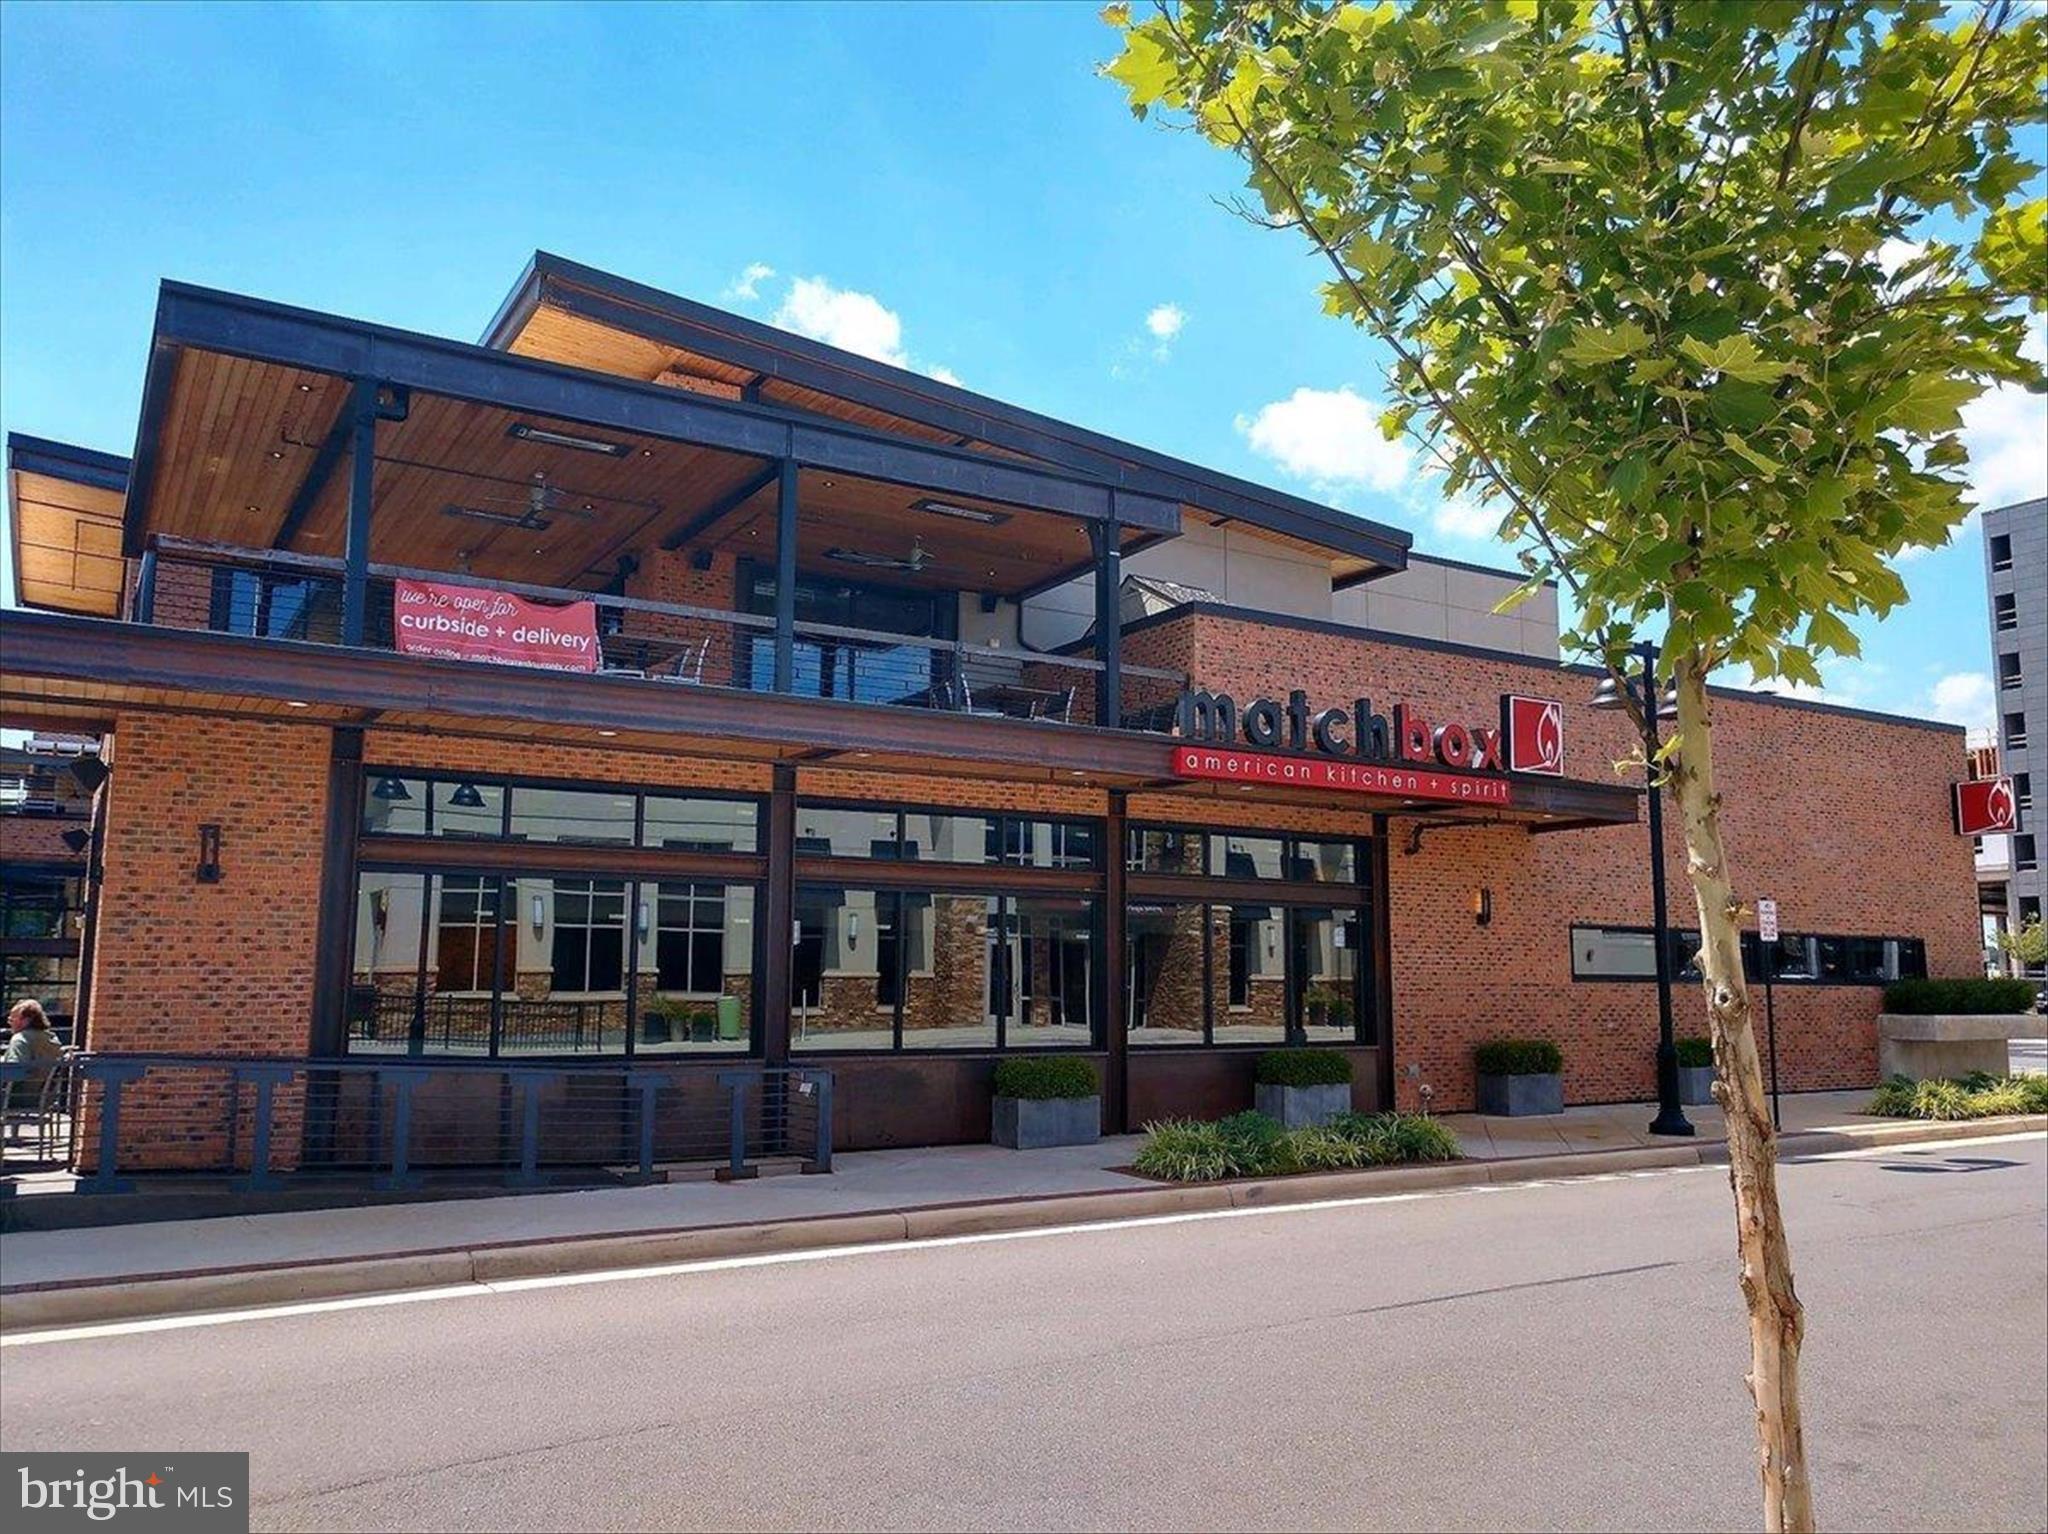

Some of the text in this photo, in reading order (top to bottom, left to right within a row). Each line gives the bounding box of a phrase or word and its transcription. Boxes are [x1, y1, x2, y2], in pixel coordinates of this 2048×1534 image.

[401, 587, 518, 619] we're open for
[401, 614, 590, 652] curbside + delivery
[405, 643, 432, 654] order
[1178, 689, 1501, 769] matchbox
[1186, 754, 1508, 797] american kitchen + spirit
